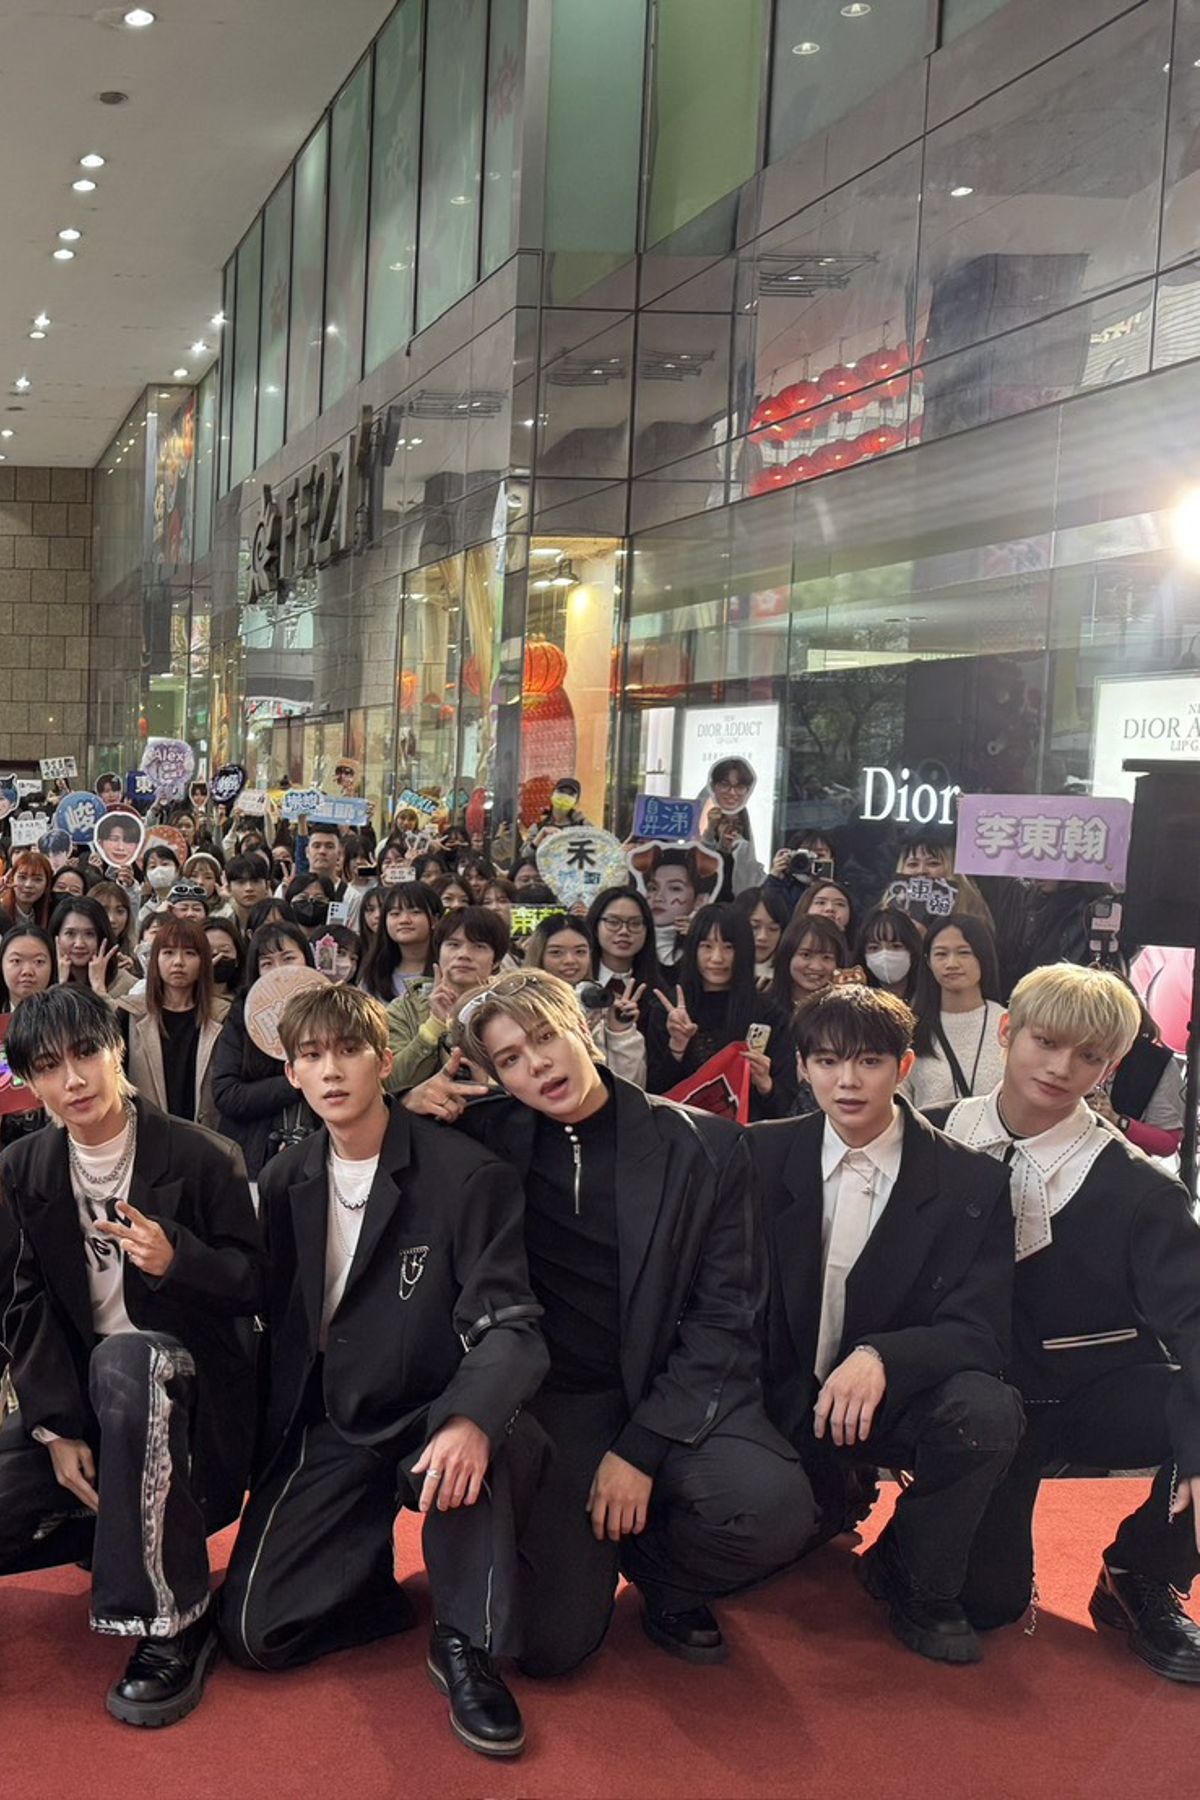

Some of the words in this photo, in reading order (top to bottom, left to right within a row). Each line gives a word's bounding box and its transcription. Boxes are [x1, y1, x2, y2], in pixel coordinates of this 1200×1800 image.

[1124, 717, 1180, 739] DIOR
[154, 748, 184, 762] Alex
[1170, 740, 1189, 752] LIP
[859, 766, 960, 825] Dior
[975, 813, 1110, 863] 李東翰
[567, 840, 596, 870] 禾
